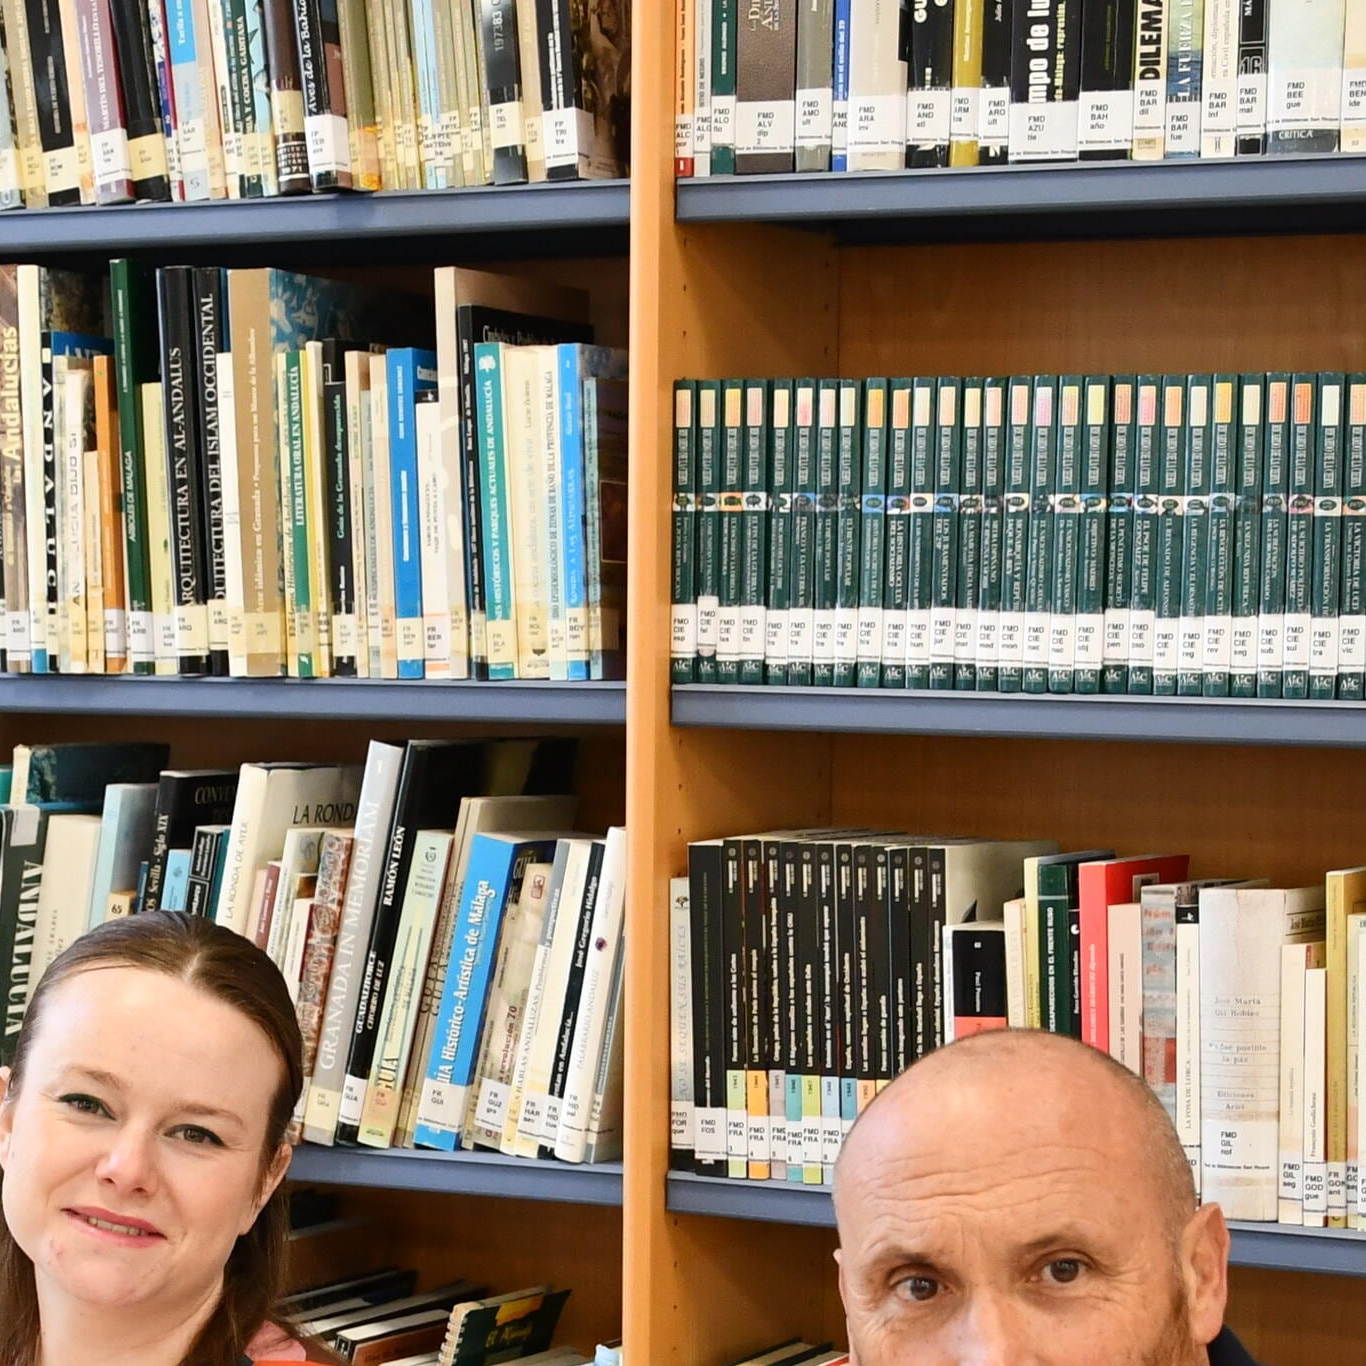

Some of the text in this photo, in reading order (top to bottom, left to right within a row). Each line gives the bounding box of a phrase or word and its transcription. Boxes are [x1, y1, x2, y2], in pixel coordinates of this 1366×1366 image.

[1286, 99, 1301, 108] gue
[1287, 81, 1305, 90] FMD
[382, 825, 405, 906] RAMÓN LEÓN
[319, 801, 380, 1070] GRANADA IN MEMORIAM
[440, 881, 495, 1061] Histórico-Artística de Málaga
